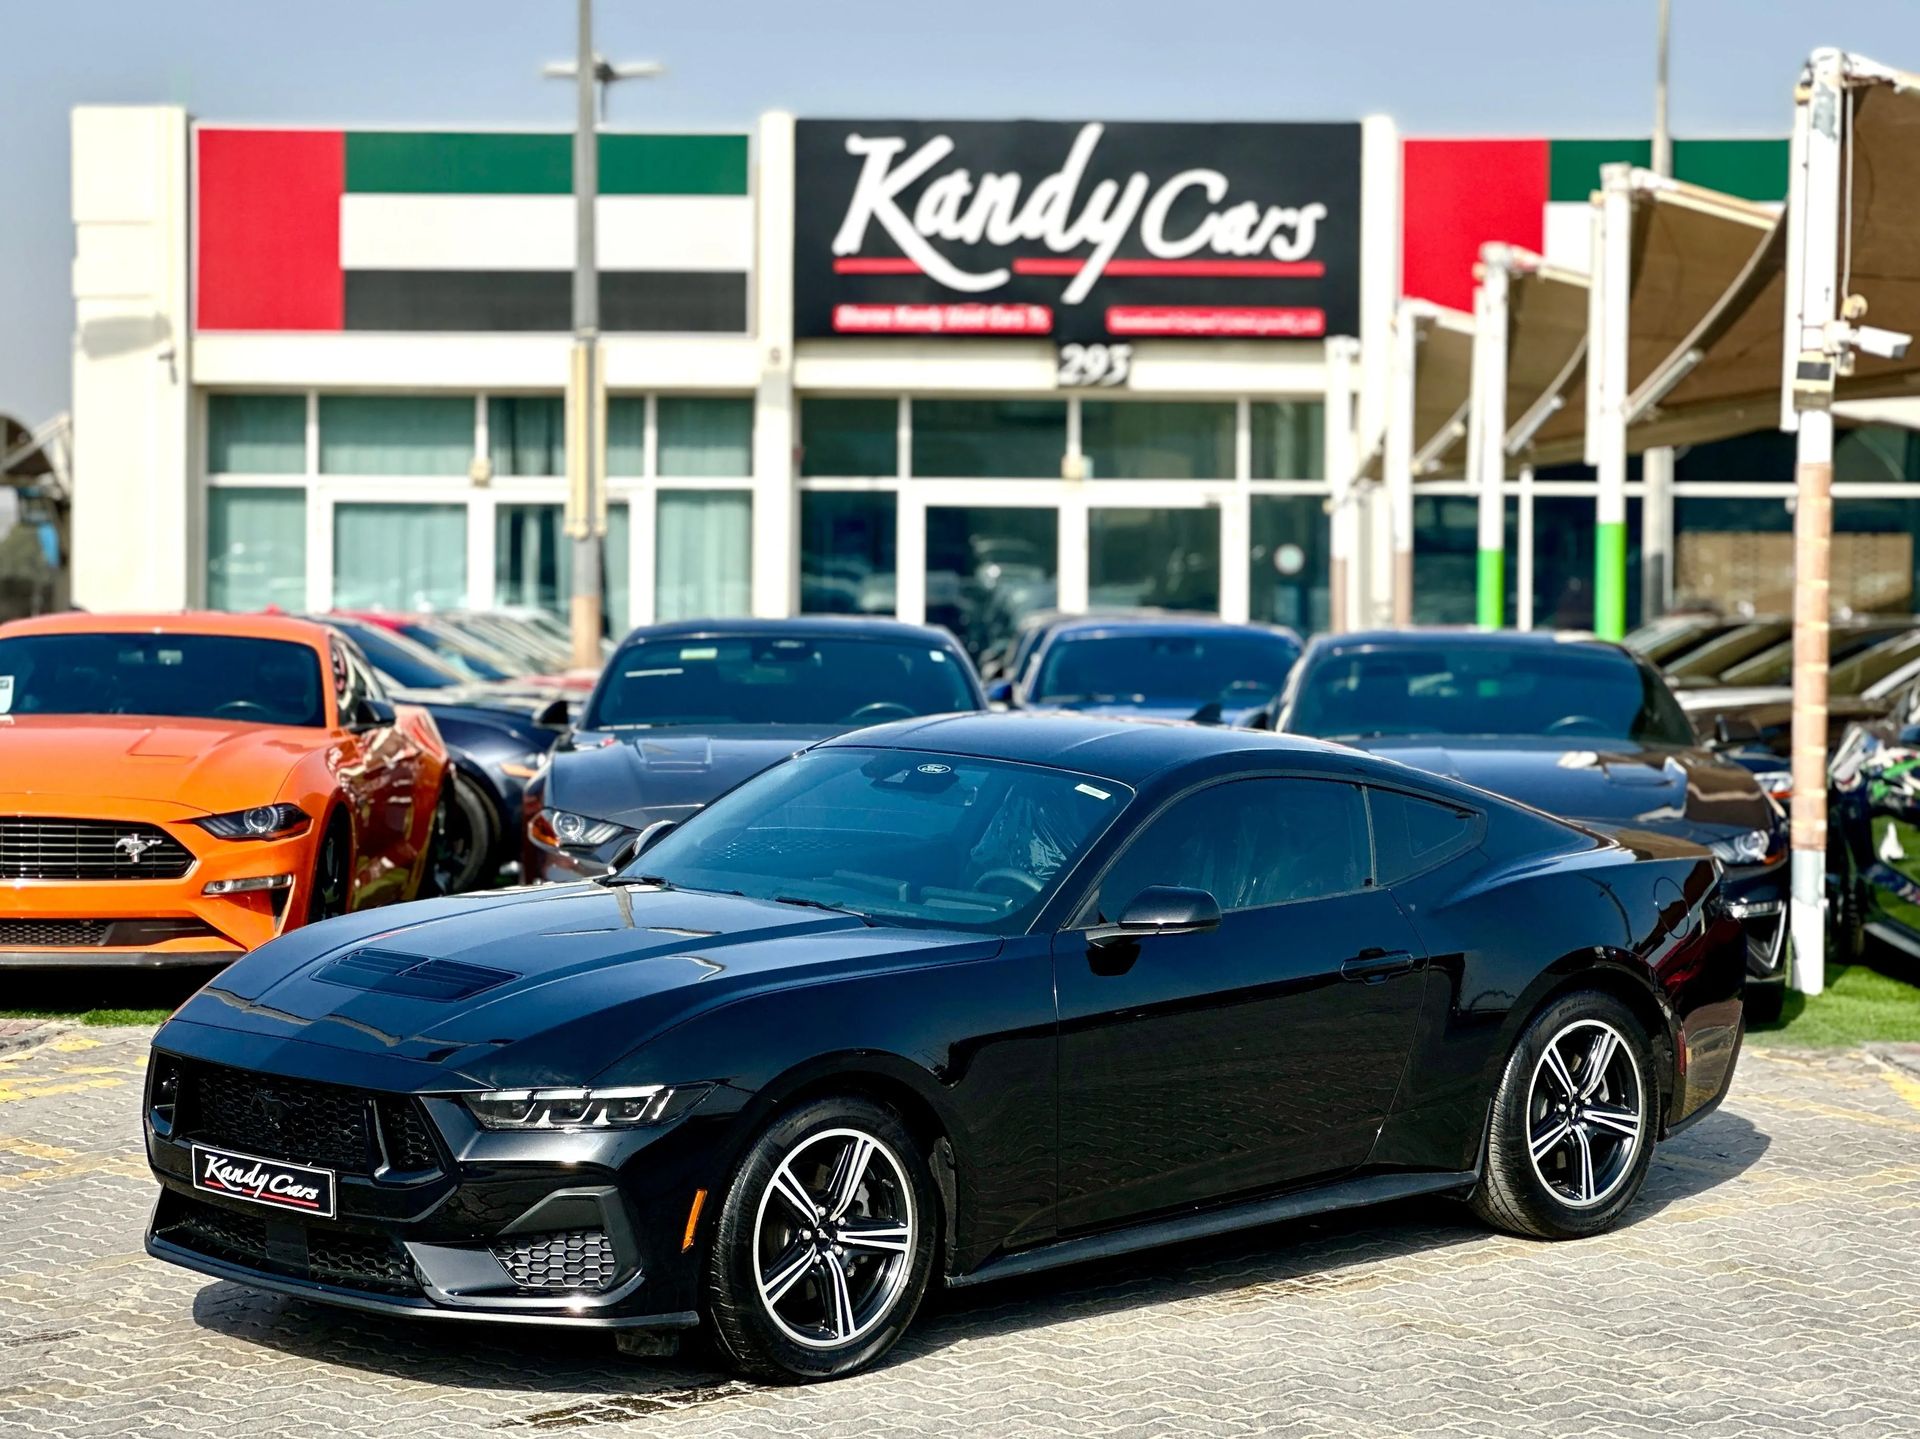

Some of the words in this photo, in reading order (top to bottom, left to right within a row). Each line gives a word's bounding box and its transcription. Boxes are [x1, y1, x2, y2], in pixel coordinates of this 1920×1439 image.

[832, 122, 1149, 304] Kandy
[1141, 168, 1327, 261] Cars
[204, 1154, 269, 1199] Kandy
[269, 1174, 319, 1200] Cars
